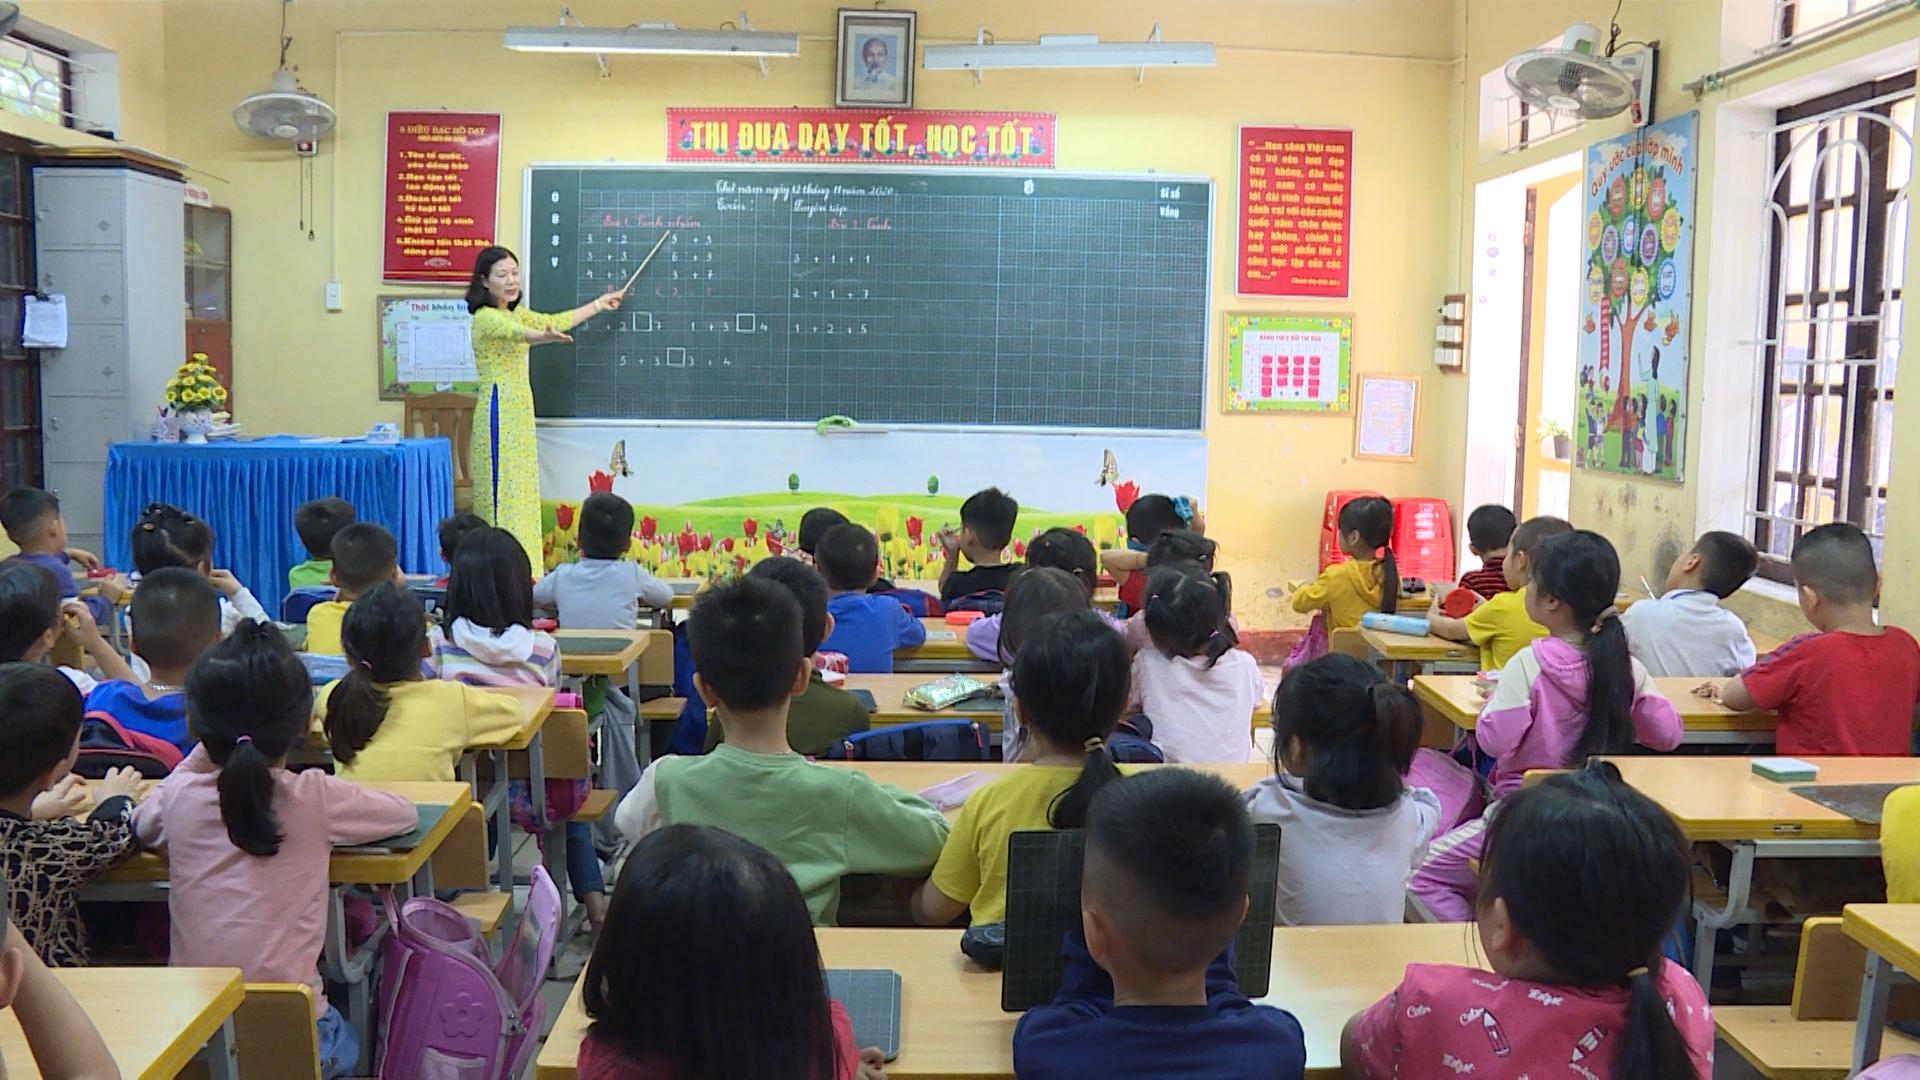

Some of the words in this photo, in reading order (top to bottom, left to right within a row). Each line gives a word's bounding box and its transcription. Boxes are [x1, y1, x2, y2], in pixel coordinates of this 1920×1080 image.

[690, 120, 728, 151] THI
[738, 121, 790, 152] ĐUA
[798, 122, 849, 156] DẠY
[926, 124, 976, 158] HỌC
[986, 118, 1033, 156] TỐT
